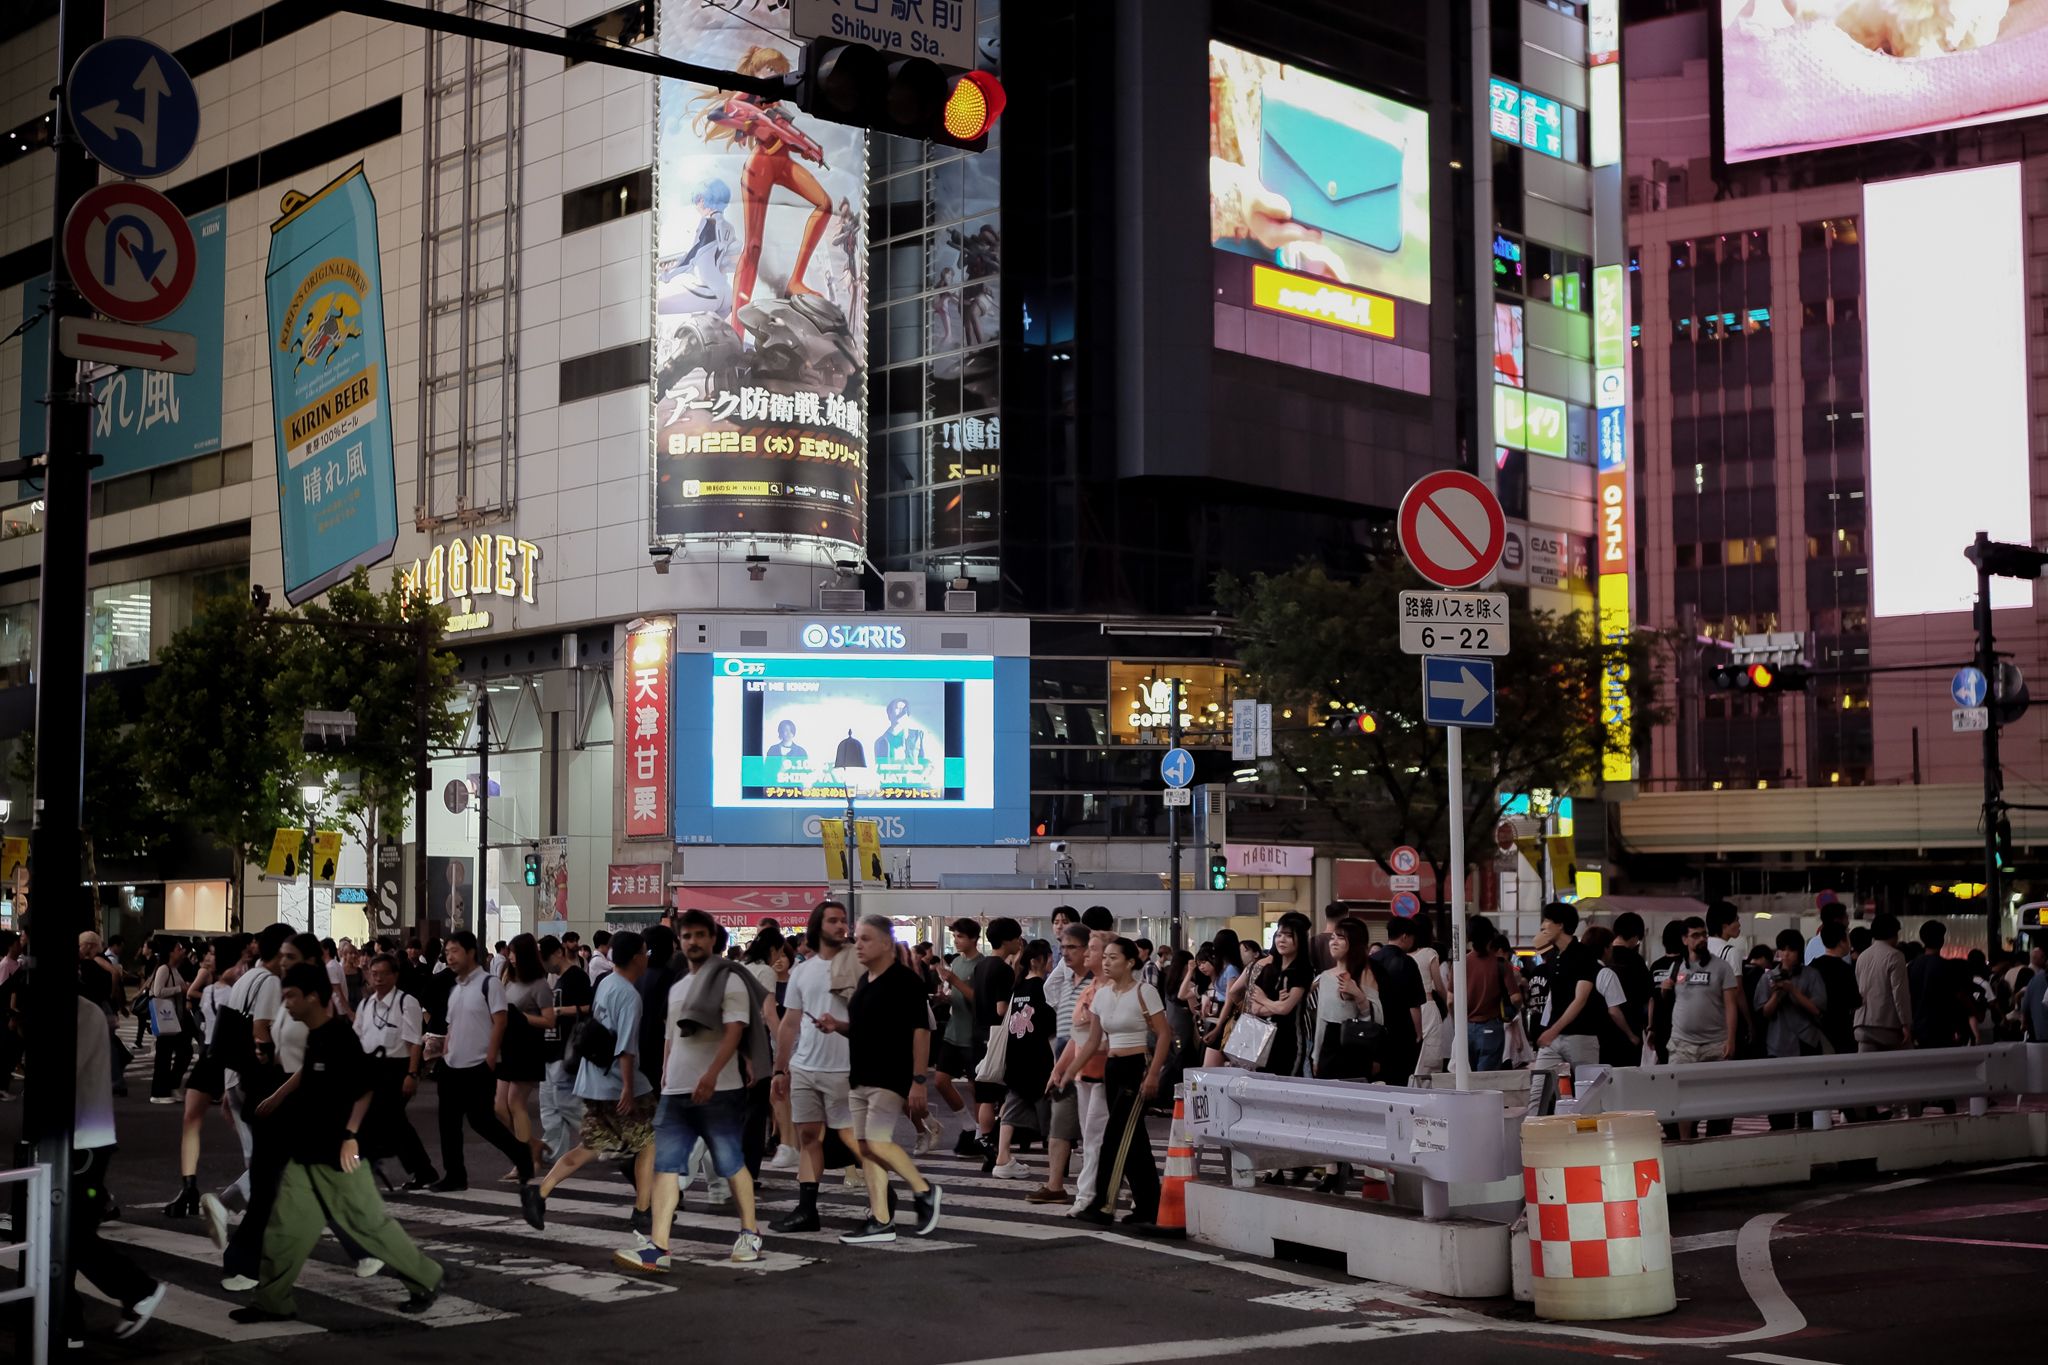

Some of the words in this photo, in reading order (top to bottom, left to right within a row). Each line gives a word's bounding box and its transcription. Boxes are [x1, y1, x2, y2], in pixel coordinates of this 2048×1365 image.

[831, 13, 902, 48] Shibuya
[910, 30, 945, 57] Sta.
[202, 223, 221, 238] KIRIN
[281, 292, 304, 345] KIRIN'S
[303, 263, 346, 294] ORIGINAL
[345, 265, 368, 293] BREW
[291, 400, 331, 441] KIRIN
[335, 376, 369, 415] BEER
[305, 415, 359, 456] 麦芽100%ビール
[302, 441, 368, 505] 晴れ風
[401, 534, 539, 623] MAGNET
[1406, 598, 1502, 619] 路線バスを除く
[1422, 627, 1489, 650] 6-22
[1128, 713, 1193, 727] COFFE
[633, 668, 660, 820] 天津甘栗
[551, 837, 568, 845] PIECE
[1243, 846, 1288, 867] MAGNET
[611, 874, 661, 895] 天津甘栗
[1192, 1094, 1209, 1120] NERO
